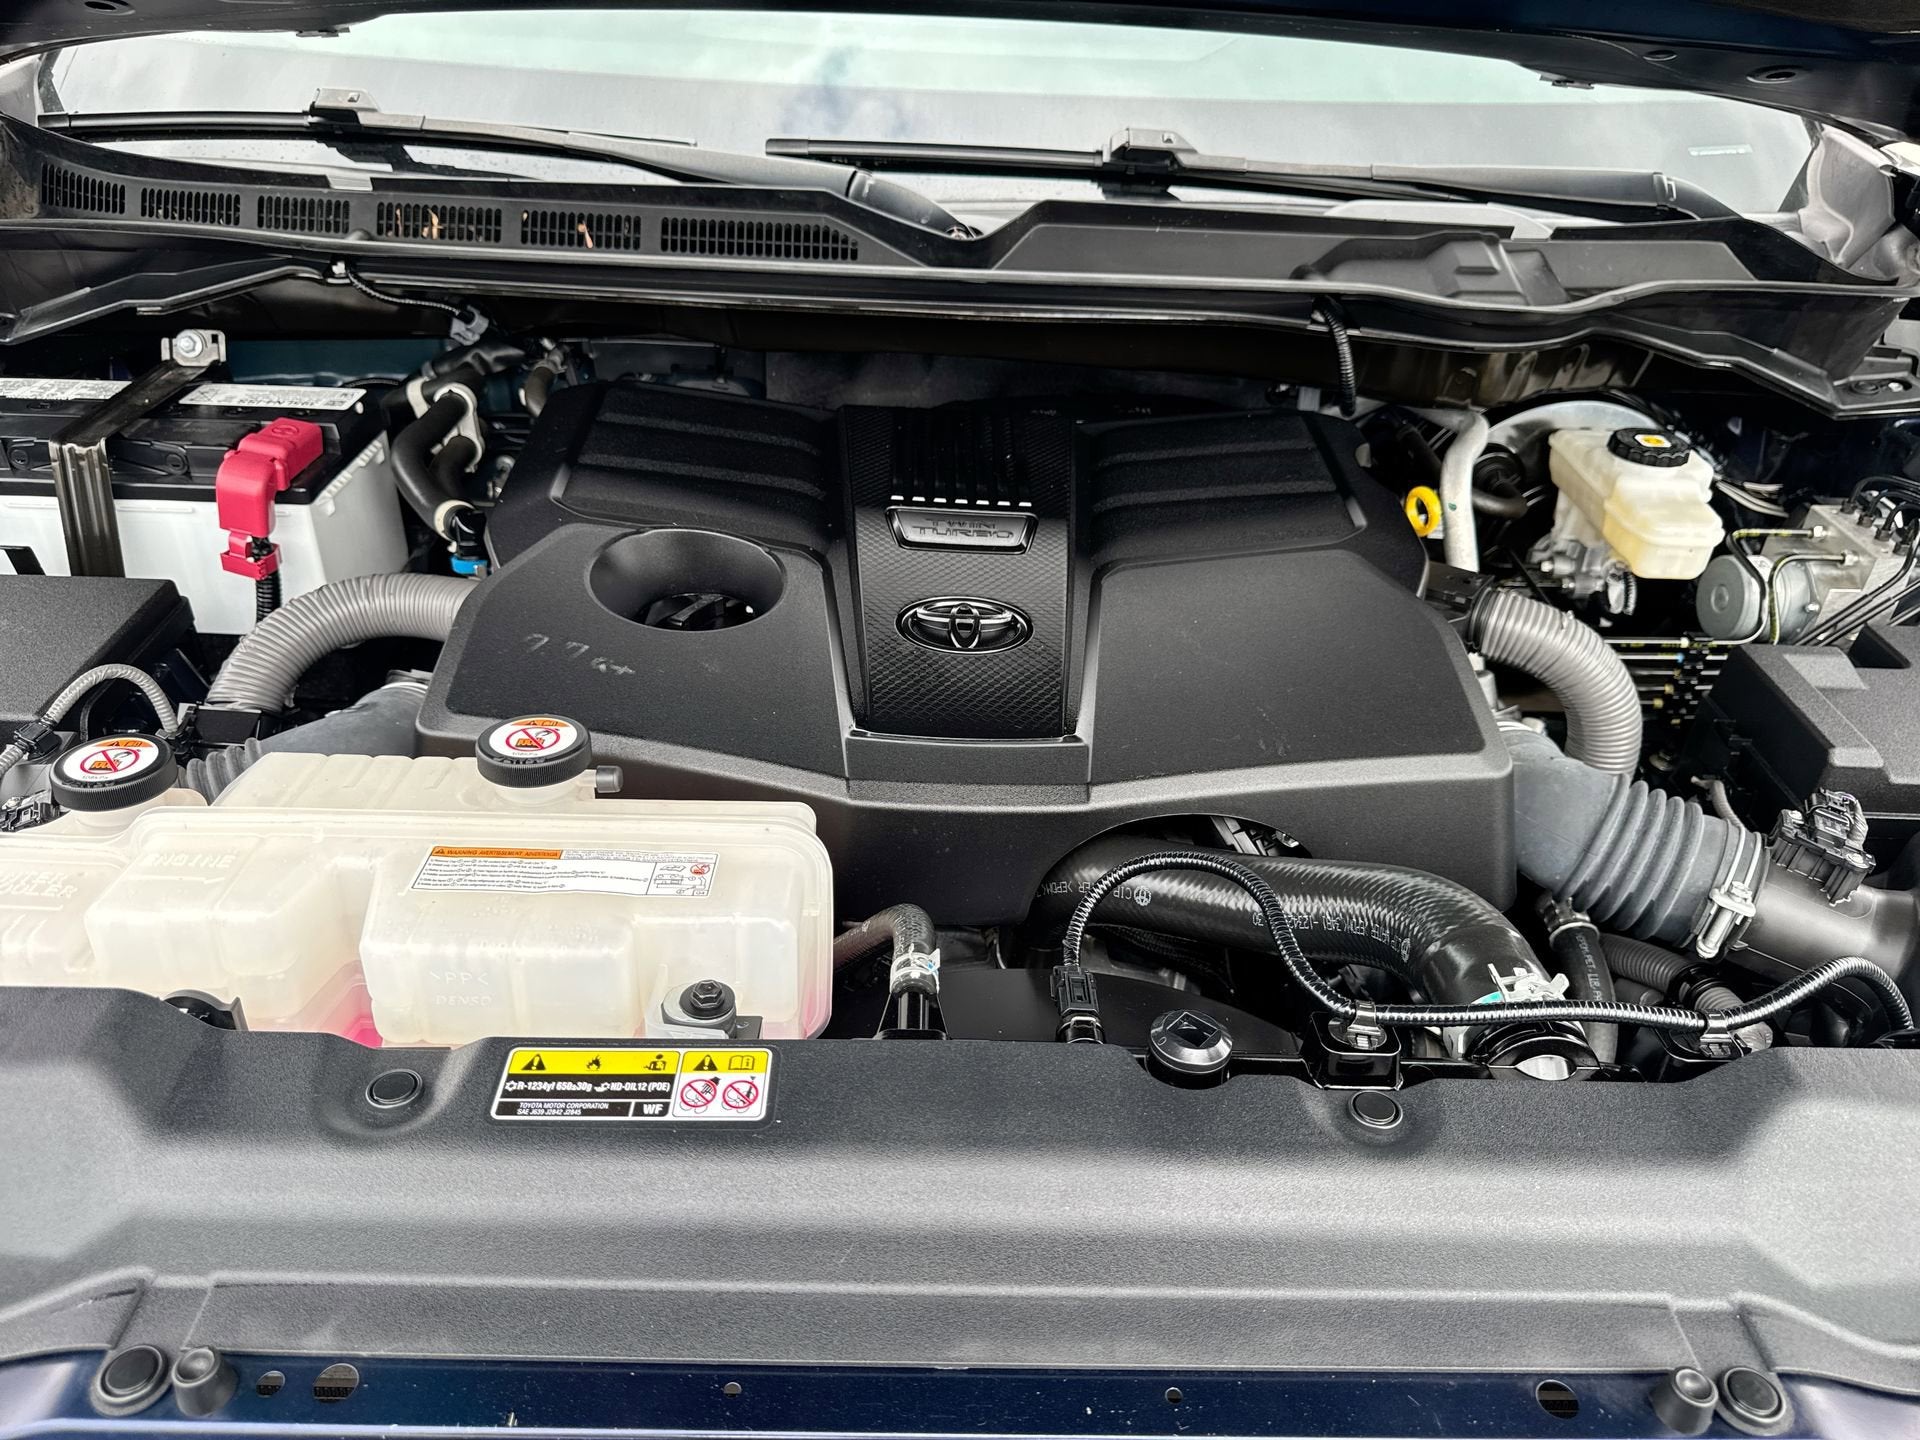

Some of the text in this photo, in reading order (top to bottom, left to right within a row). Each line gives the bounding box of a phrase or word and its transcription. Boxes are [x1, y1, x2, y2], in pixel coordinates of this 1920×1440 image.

[926, 518, 996, 529] TWIN
[912, 526, 1014, 539] TURBO
[517, 1081, 555, 1092] R-1234yf
[647, 1081, 671, 1092] (POE)
[643, 1103, 664, 1115] WF
